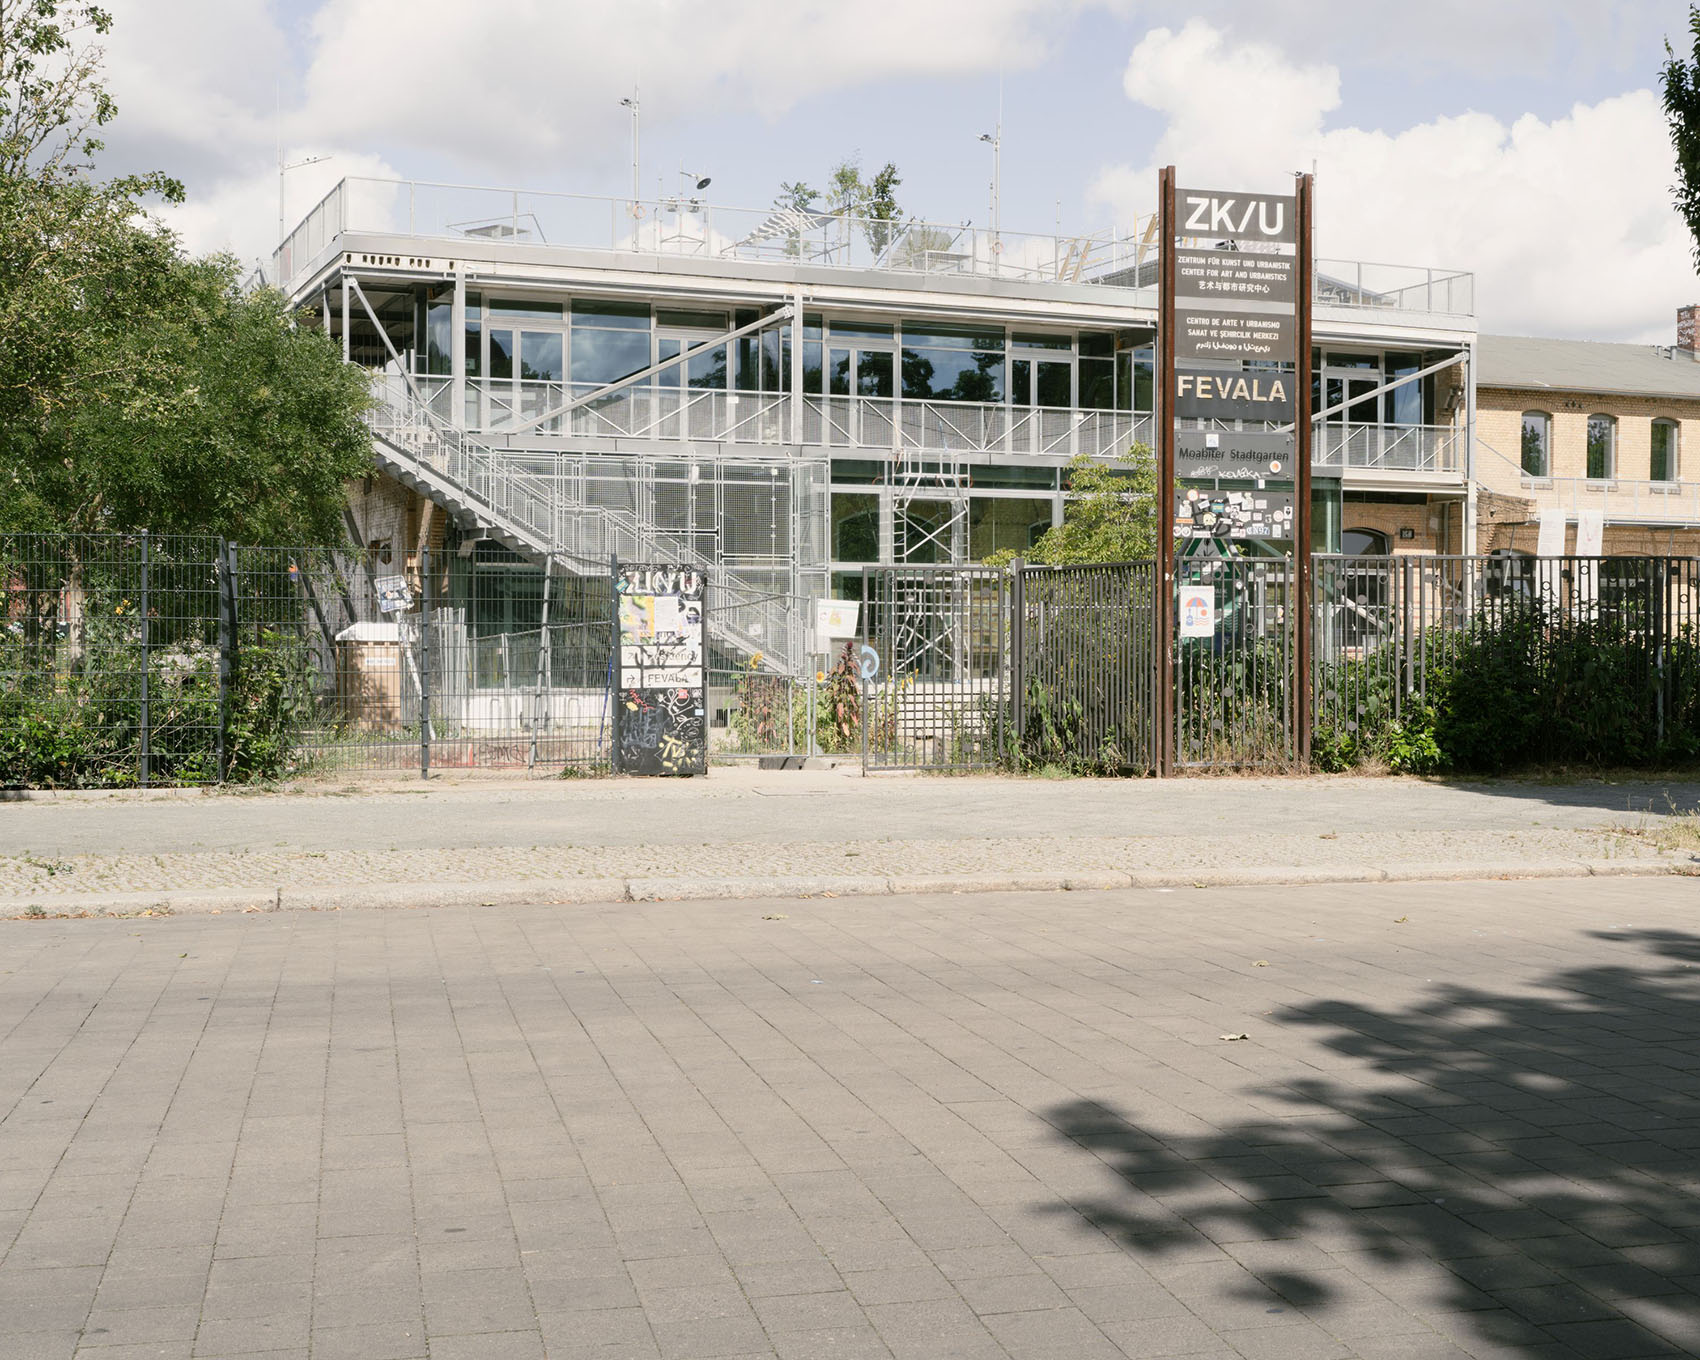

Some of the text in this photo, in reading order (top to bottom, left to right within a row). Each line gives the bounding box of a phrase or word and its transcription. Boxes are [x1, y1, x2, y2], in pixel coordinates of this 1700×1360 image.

[1185, 197, 1284, 236] ZK/U
[1178, 256, 1291, 270] ZENTRUM FÜR KUNST UND URBANISTIK
[1181, 268, 1287, 281] CENTER FOR ART AND URBANISTICS
[1199, 280, 1270, 294] 艺术与都市研究中心
[1186, 317, 1210, 326] CENTRO
[1212, 318, 1220, 326] DE
[1222, 319, 1238, 327] ARTE
[1246, 320, 1280, 329] URBANISMO
[1187, 328, 1208, 337] SANAT
[1210, 329, 1218, 337] VE
[1177, 375, 1287, 403] FEVALA
[1179, 447, 1289, 463] Moabiter Stadtgarten
